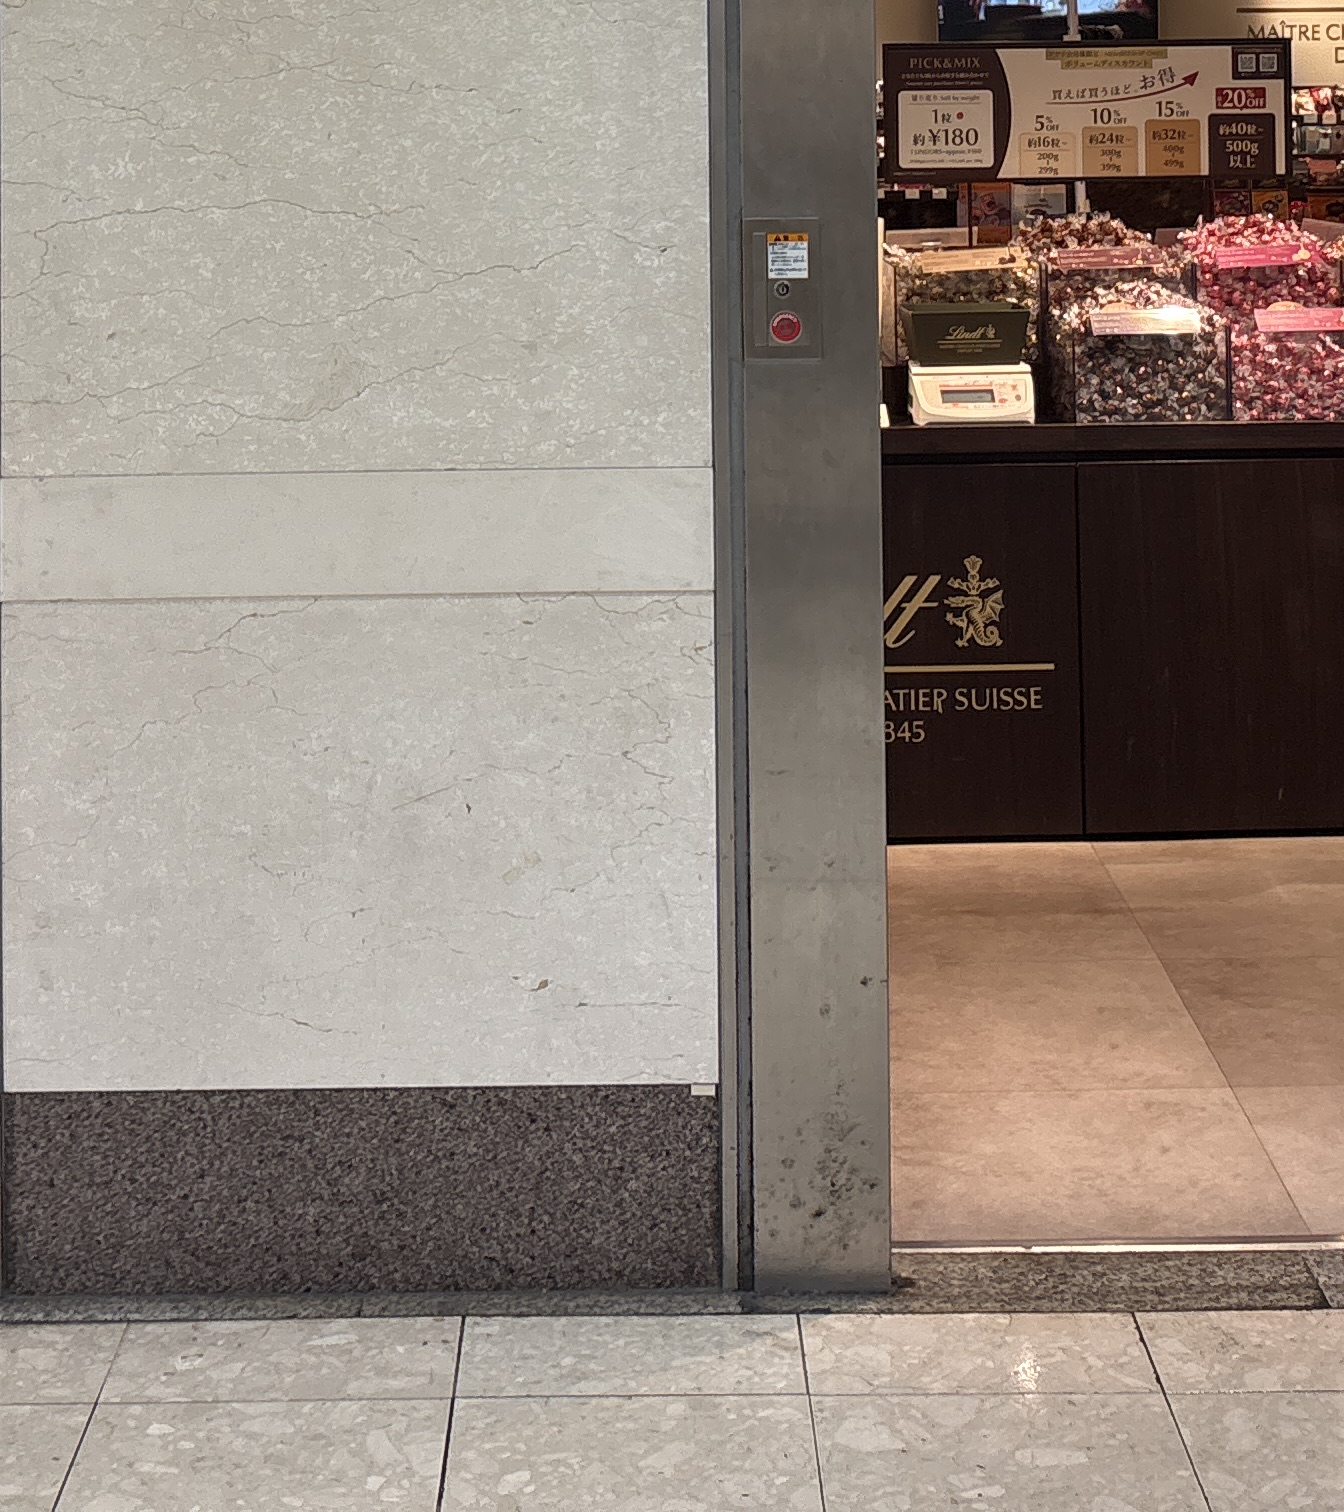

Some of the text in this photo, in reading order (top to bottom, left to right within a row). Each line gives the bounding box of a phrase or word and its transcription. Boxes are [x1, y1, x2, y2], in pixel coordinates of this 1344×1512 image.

[909, 57, 981, 69] PICK&MIX
[1225, 140, 1259, 155] 500g
[944, 325, 986, 340] Lindt
[954, 686, 1043, 711] SUISSE
